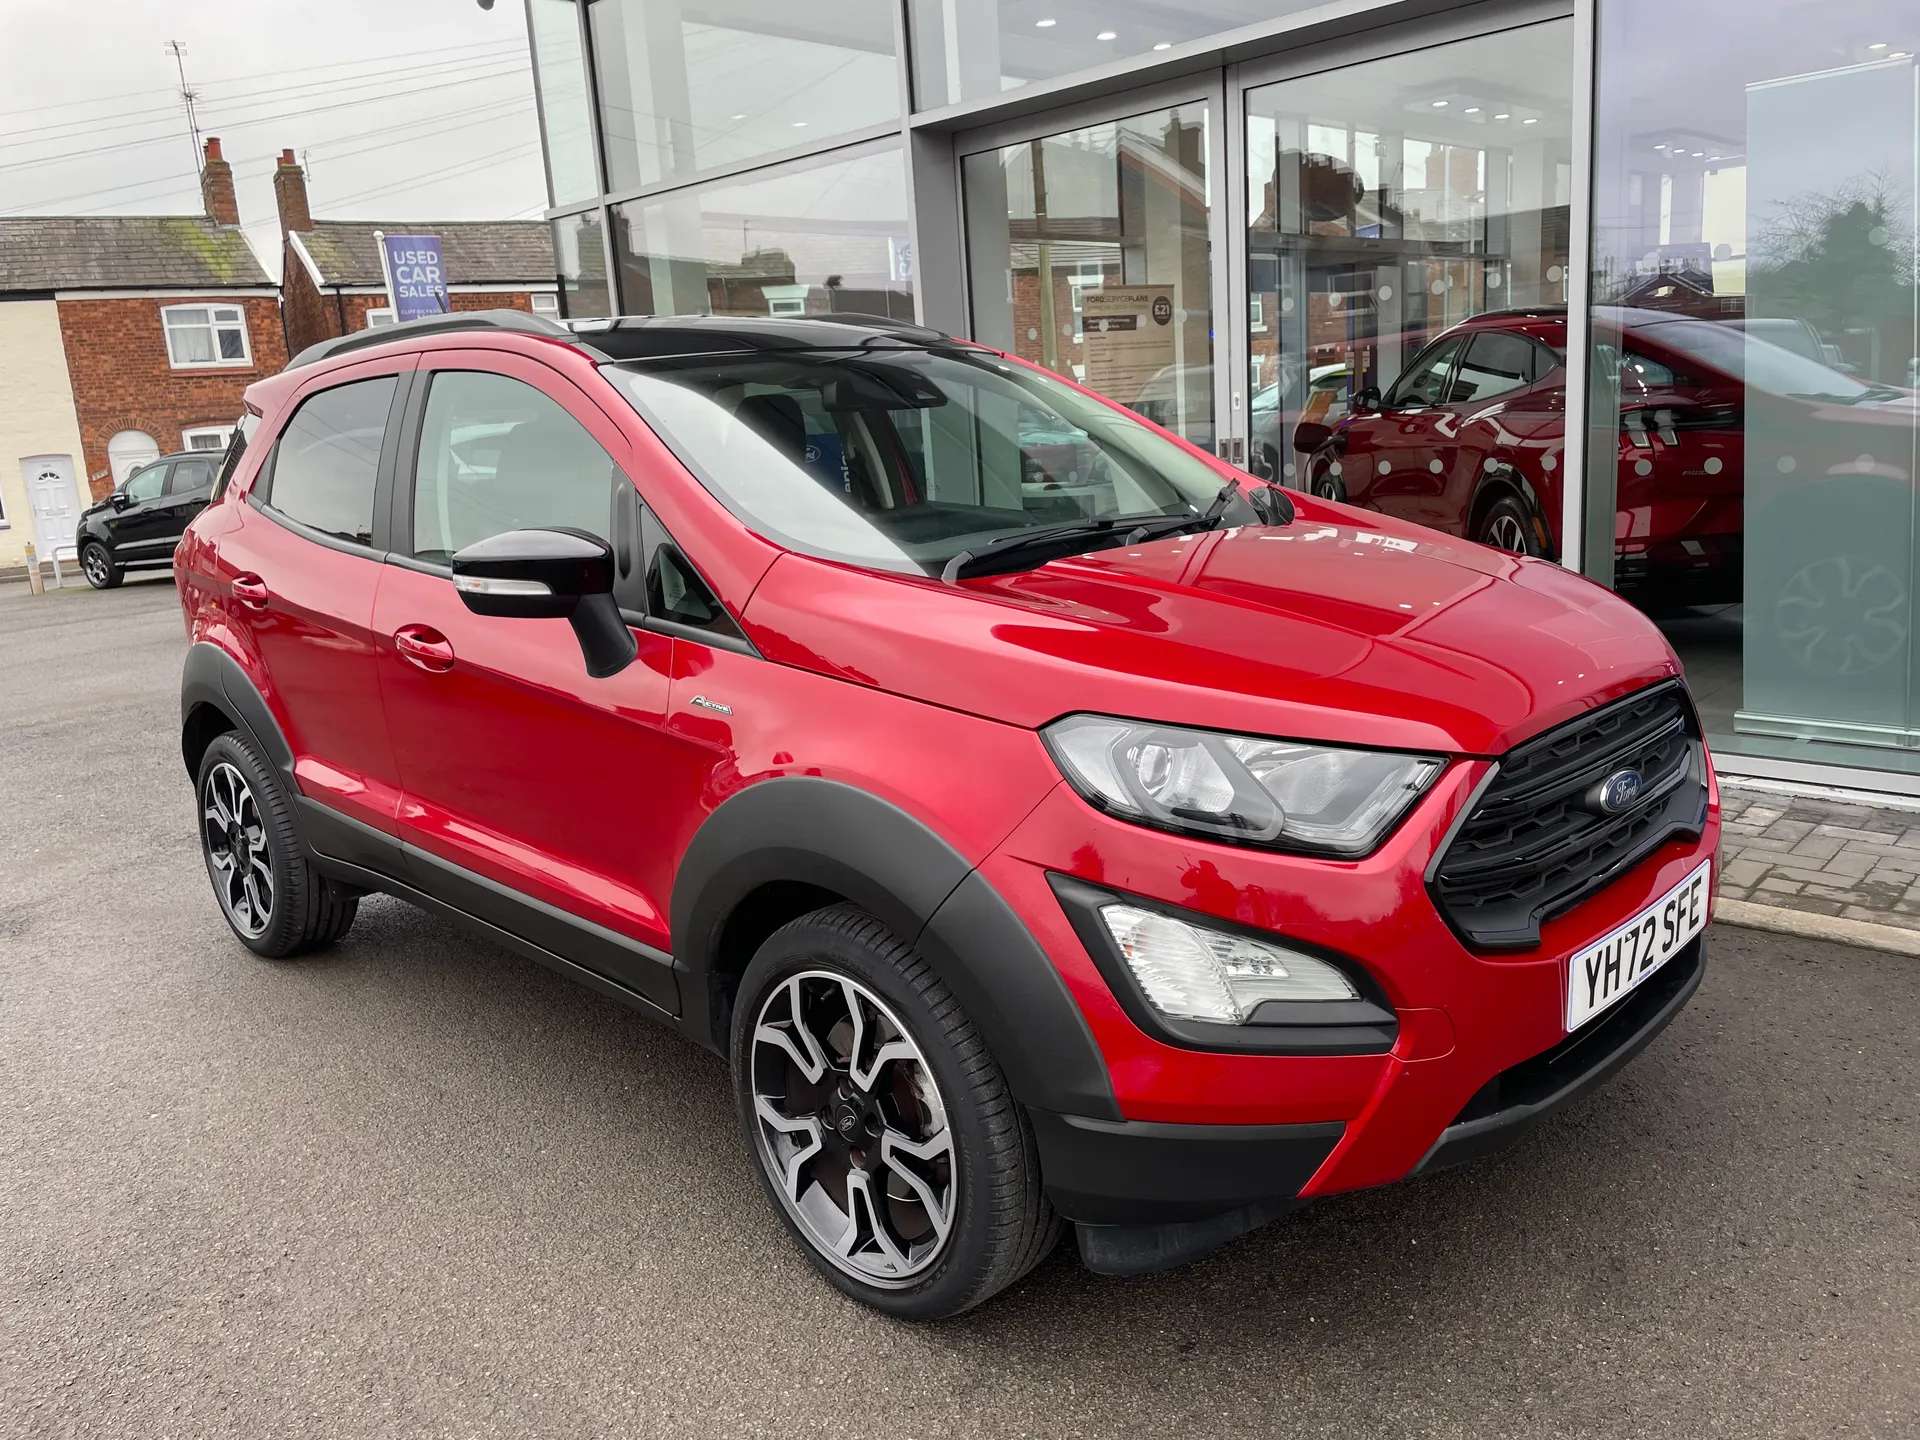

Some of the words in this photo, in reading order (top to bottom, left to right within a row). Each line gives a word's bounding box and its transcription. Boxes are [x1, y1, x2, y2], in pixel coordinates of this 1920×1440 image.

[393, 251, 438, 265] USED
[396, 266, 441, 283] CAR
[399, 285, 444, 297] SALES
[1615, 777, 1639, 805] Ford
[1585, 915, 1656, 1009] YH72
[1661, 876, 1702, 953] SFE
